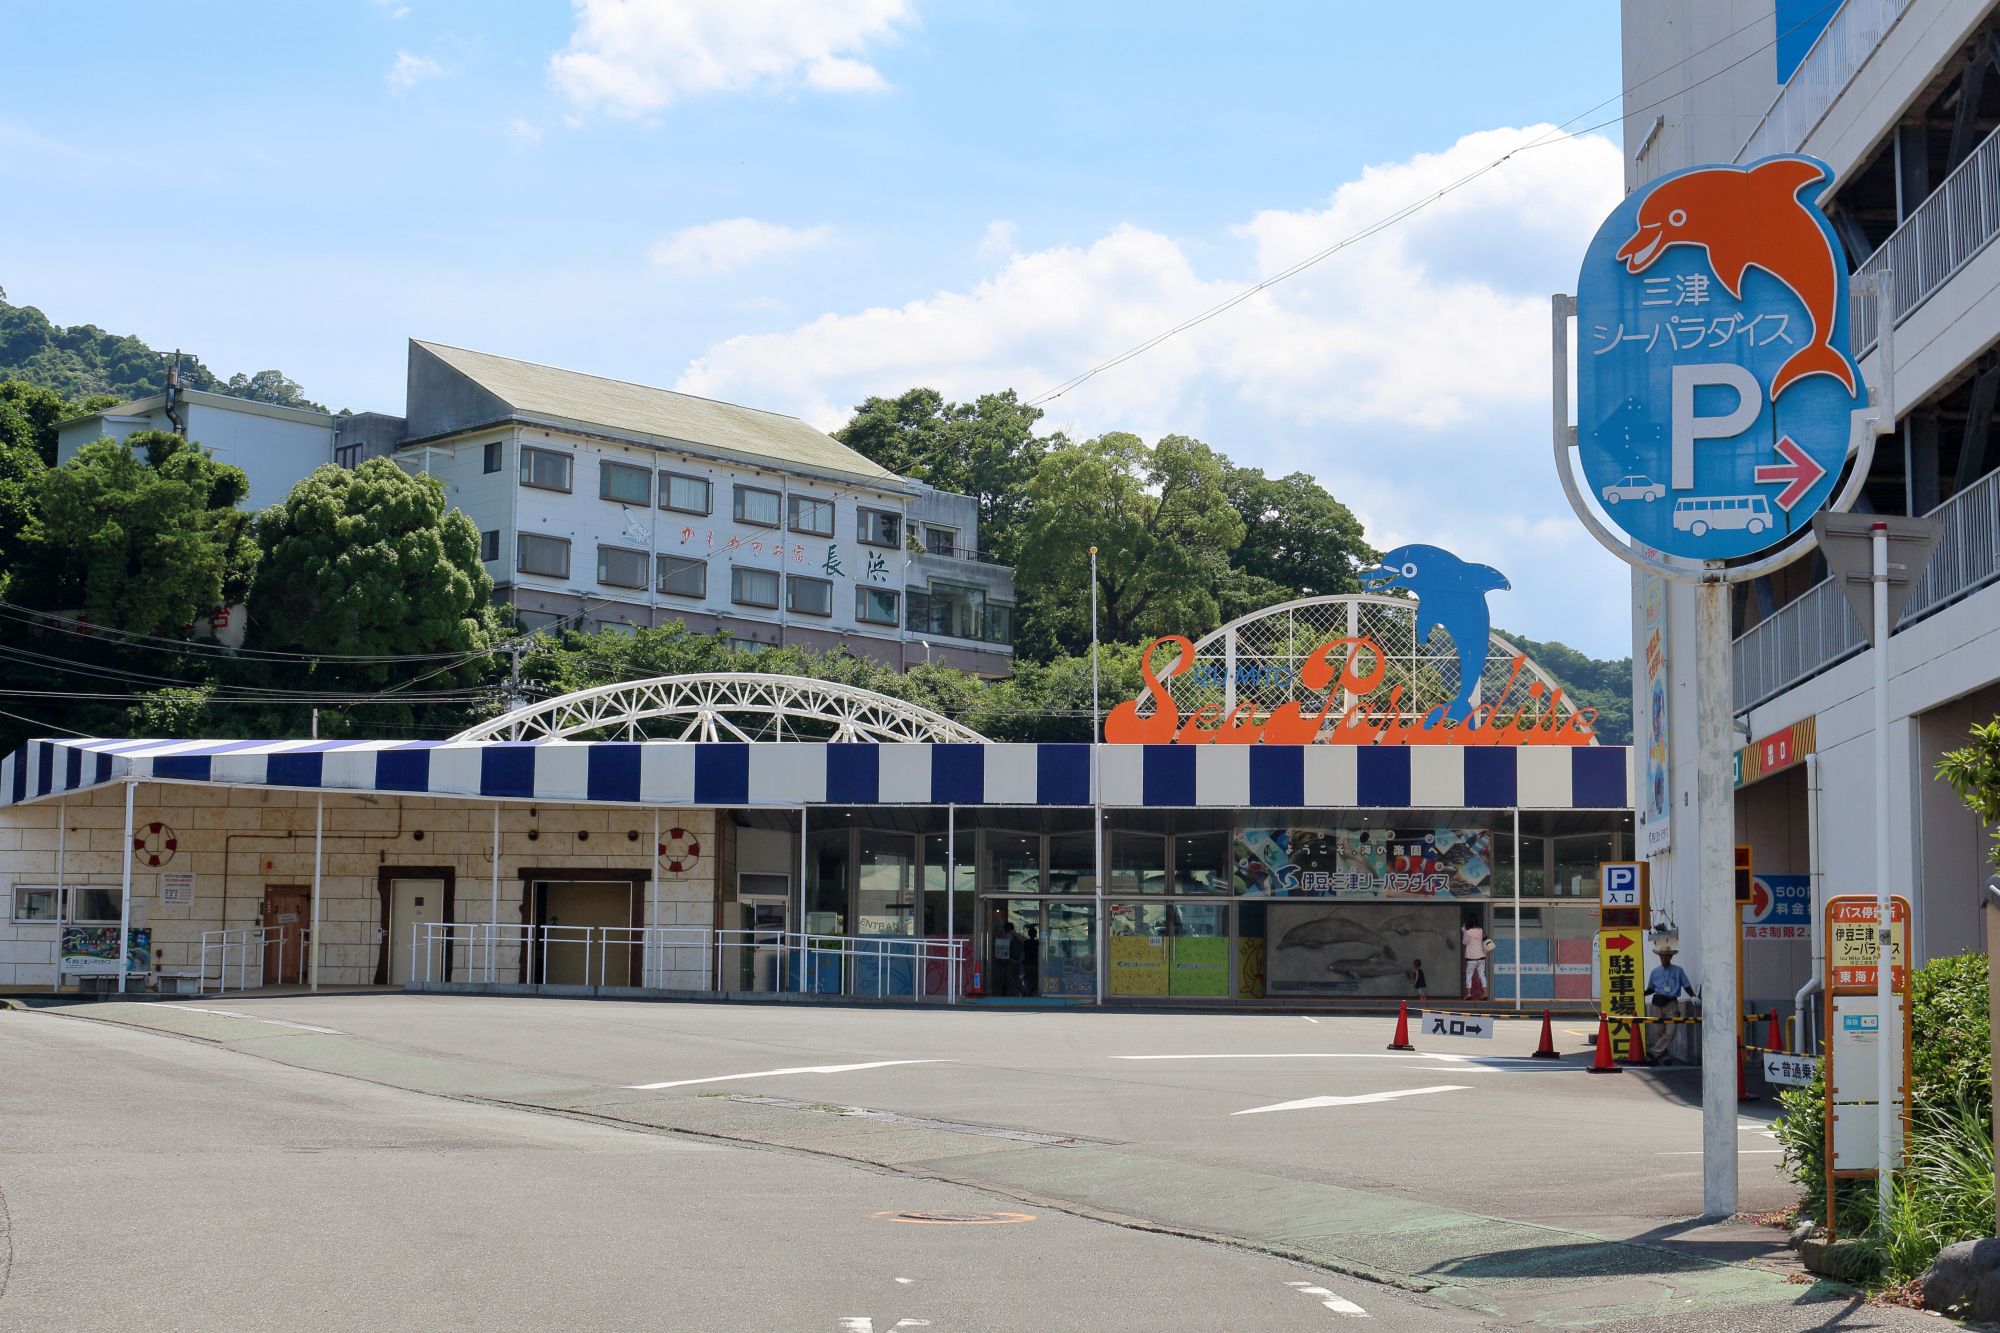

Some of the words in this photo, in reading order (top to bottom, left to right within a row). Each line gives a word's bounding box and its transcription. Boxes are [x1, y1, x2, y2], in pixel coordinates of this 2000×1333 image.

[1641, 273, 1710, 307] 三津
[1592, 311, 1795, 355] シーパラダイス
[1672, 363, 1763, 490] P
[681, 526, 805, 564] かもめのお宿
[822, 544, 890, 582] 長浜
[1104, 634, 1263, 744] Sea
[1264, 635, 1599, 745] Paradise
[1767, 741, 1786, 766] 出口
[1610, 869, 1633, 890] P
[1609, 893, 1634, 903] 入口
[1776, 886, 1811, 898] 500
[1776, 902, 1811, 915] 料金
[1836, 928, 1874, 942] 伊豆三津
[1844, 942, 1900, 955] シーパラス
[1431, 1018, 1466, 1036] 入口
[1781, 1061, 1816, 1079] 普通乗
